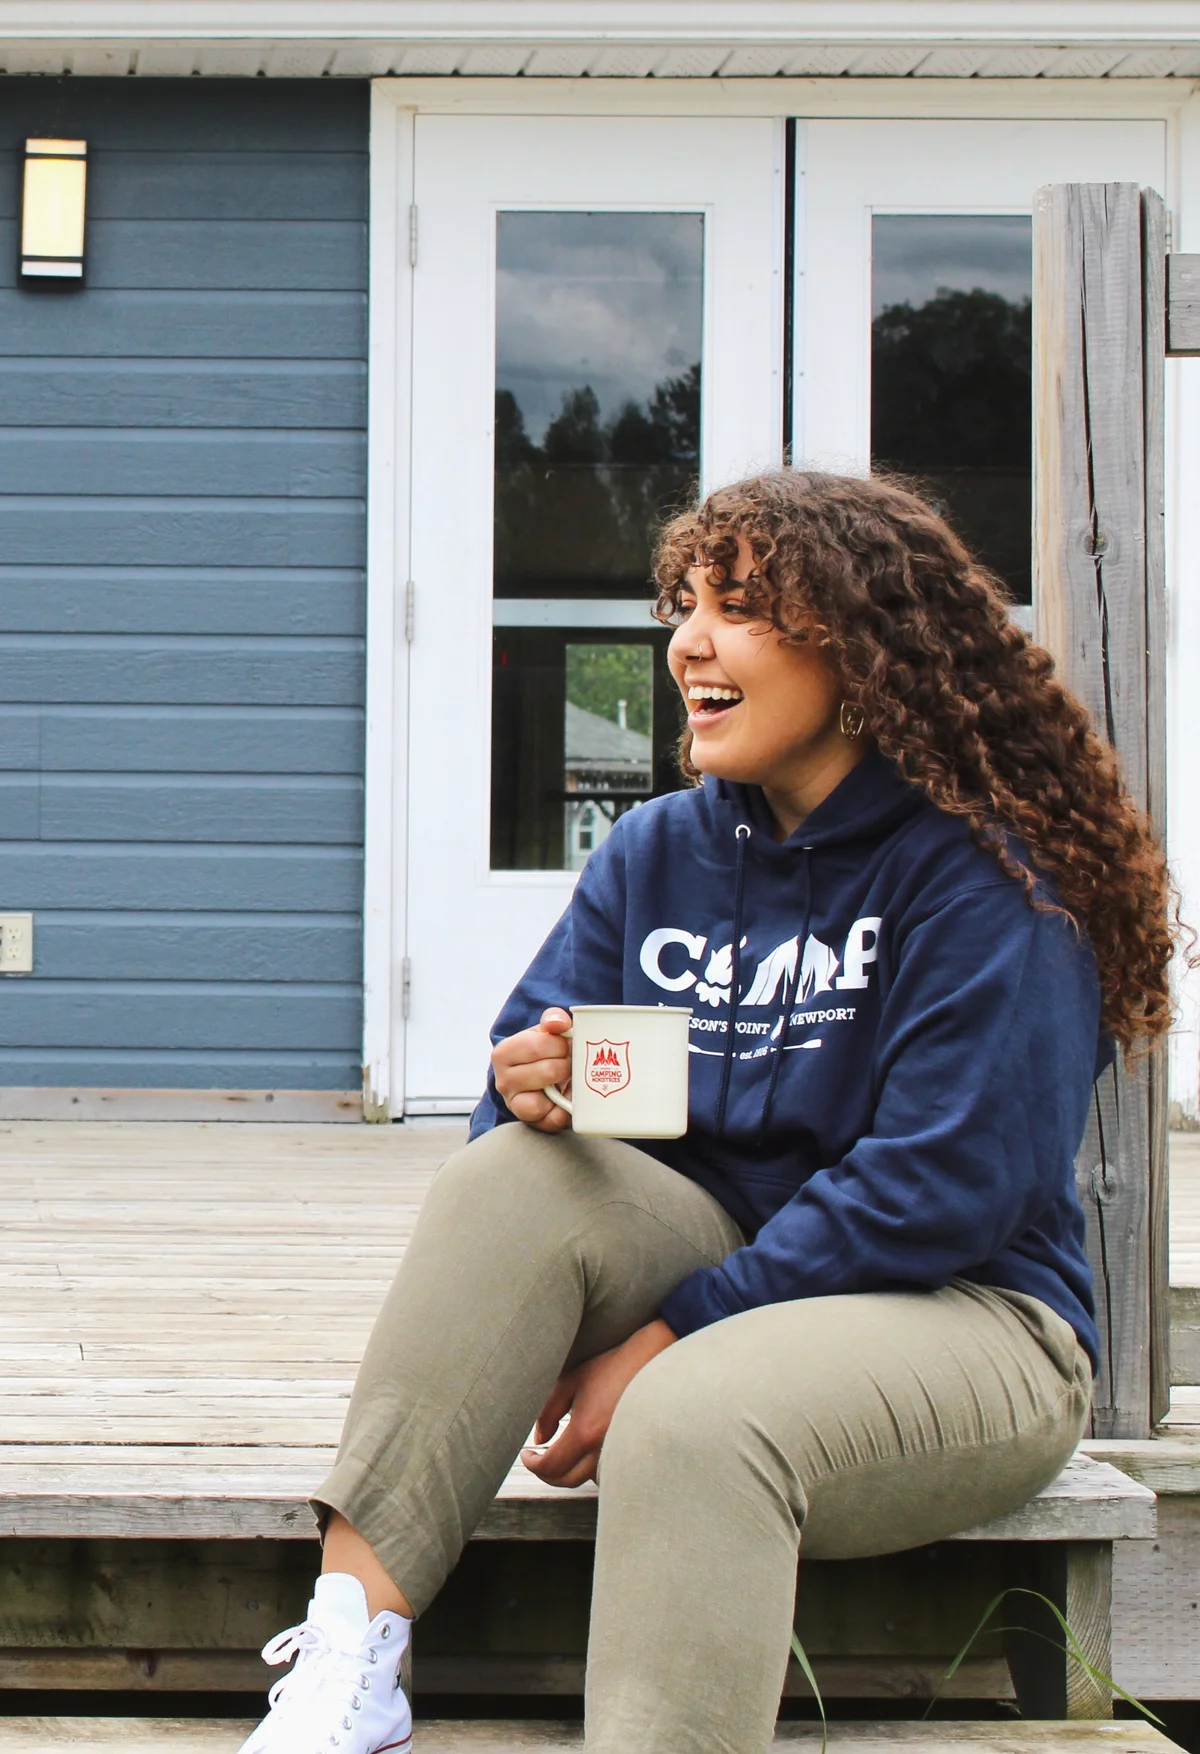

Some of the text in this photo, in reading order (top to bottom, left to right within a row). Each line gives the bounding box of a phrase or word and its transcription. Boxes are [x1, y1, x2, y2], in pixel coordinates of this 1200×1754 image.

[734, 1021, 770, 1035] OINT
[789, 1008, 856, 1027] NEWPORT
[590, 1070, 622, 1078] CAMPING
